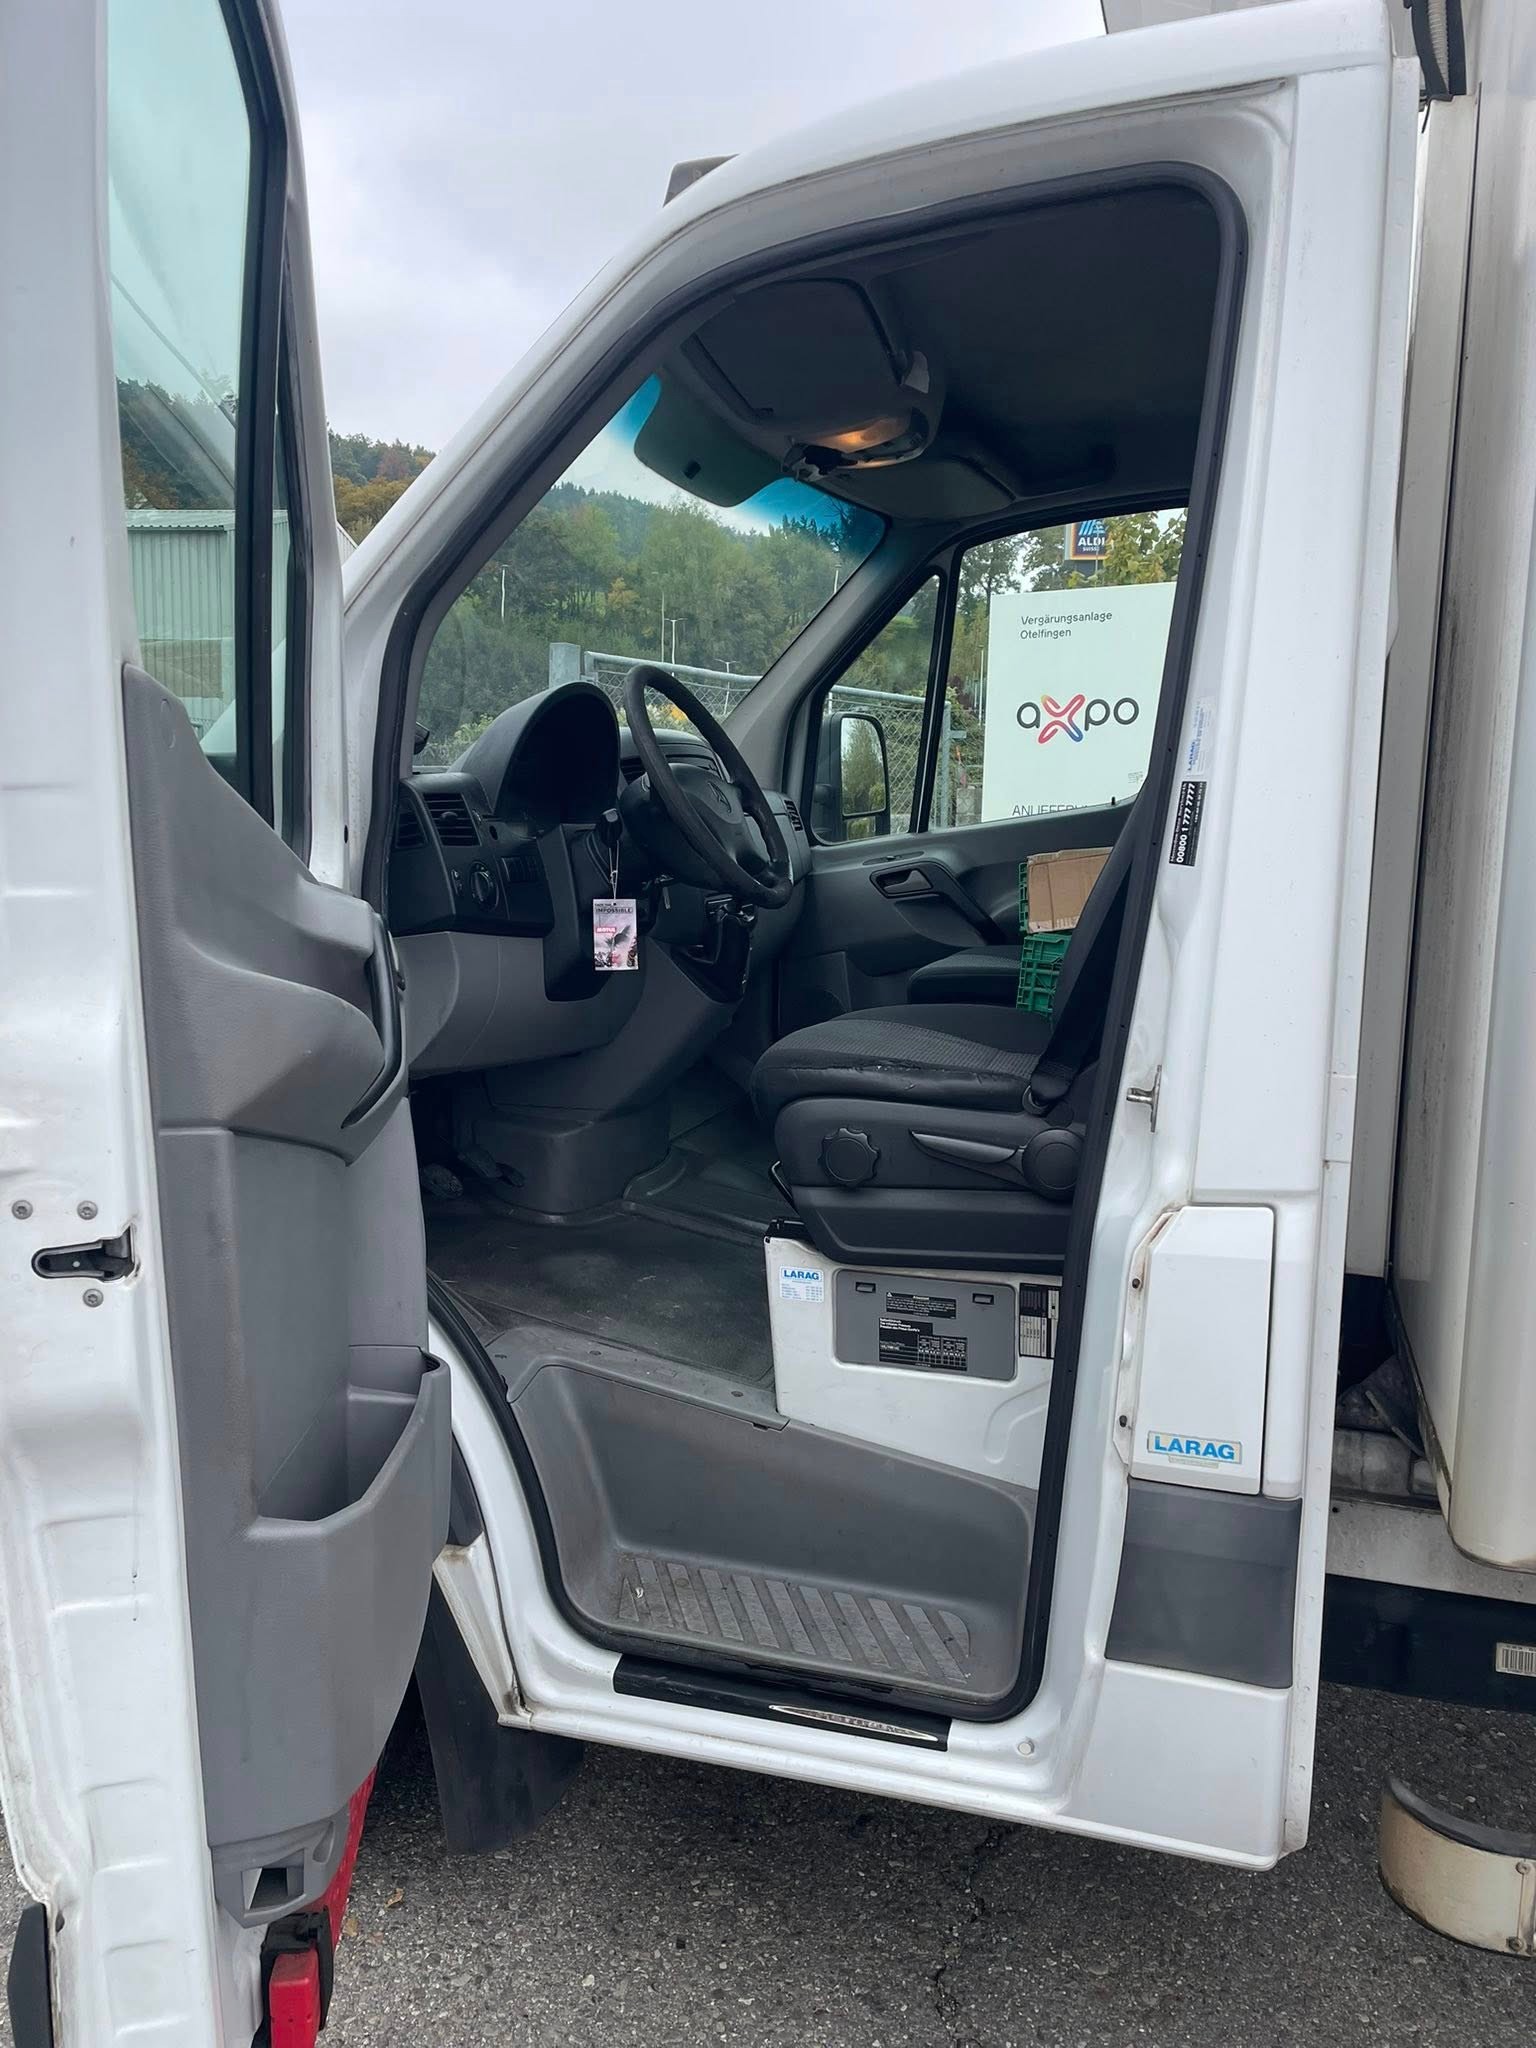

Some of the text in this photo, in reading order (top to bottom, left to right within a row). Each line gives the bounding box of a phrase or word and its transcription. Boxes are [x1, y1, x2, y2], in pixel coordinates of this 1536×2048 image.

[1077, 536, 1106, 547] ALDI
[1020, 611, 1113, 627] Vergärungsanlage
[1019, 628, 1072, 640] Otelfingen
[1016, 694, 1140, 744] axpo
[1185, 783, 1196, 807] 7777
[1182, 807, 1192, 826] 777
[1176, 834, 1188, 863] 00800
[783, 1269, 820, 1281] LARAG
[1154, 1435, 1236, 1461] LARAG
